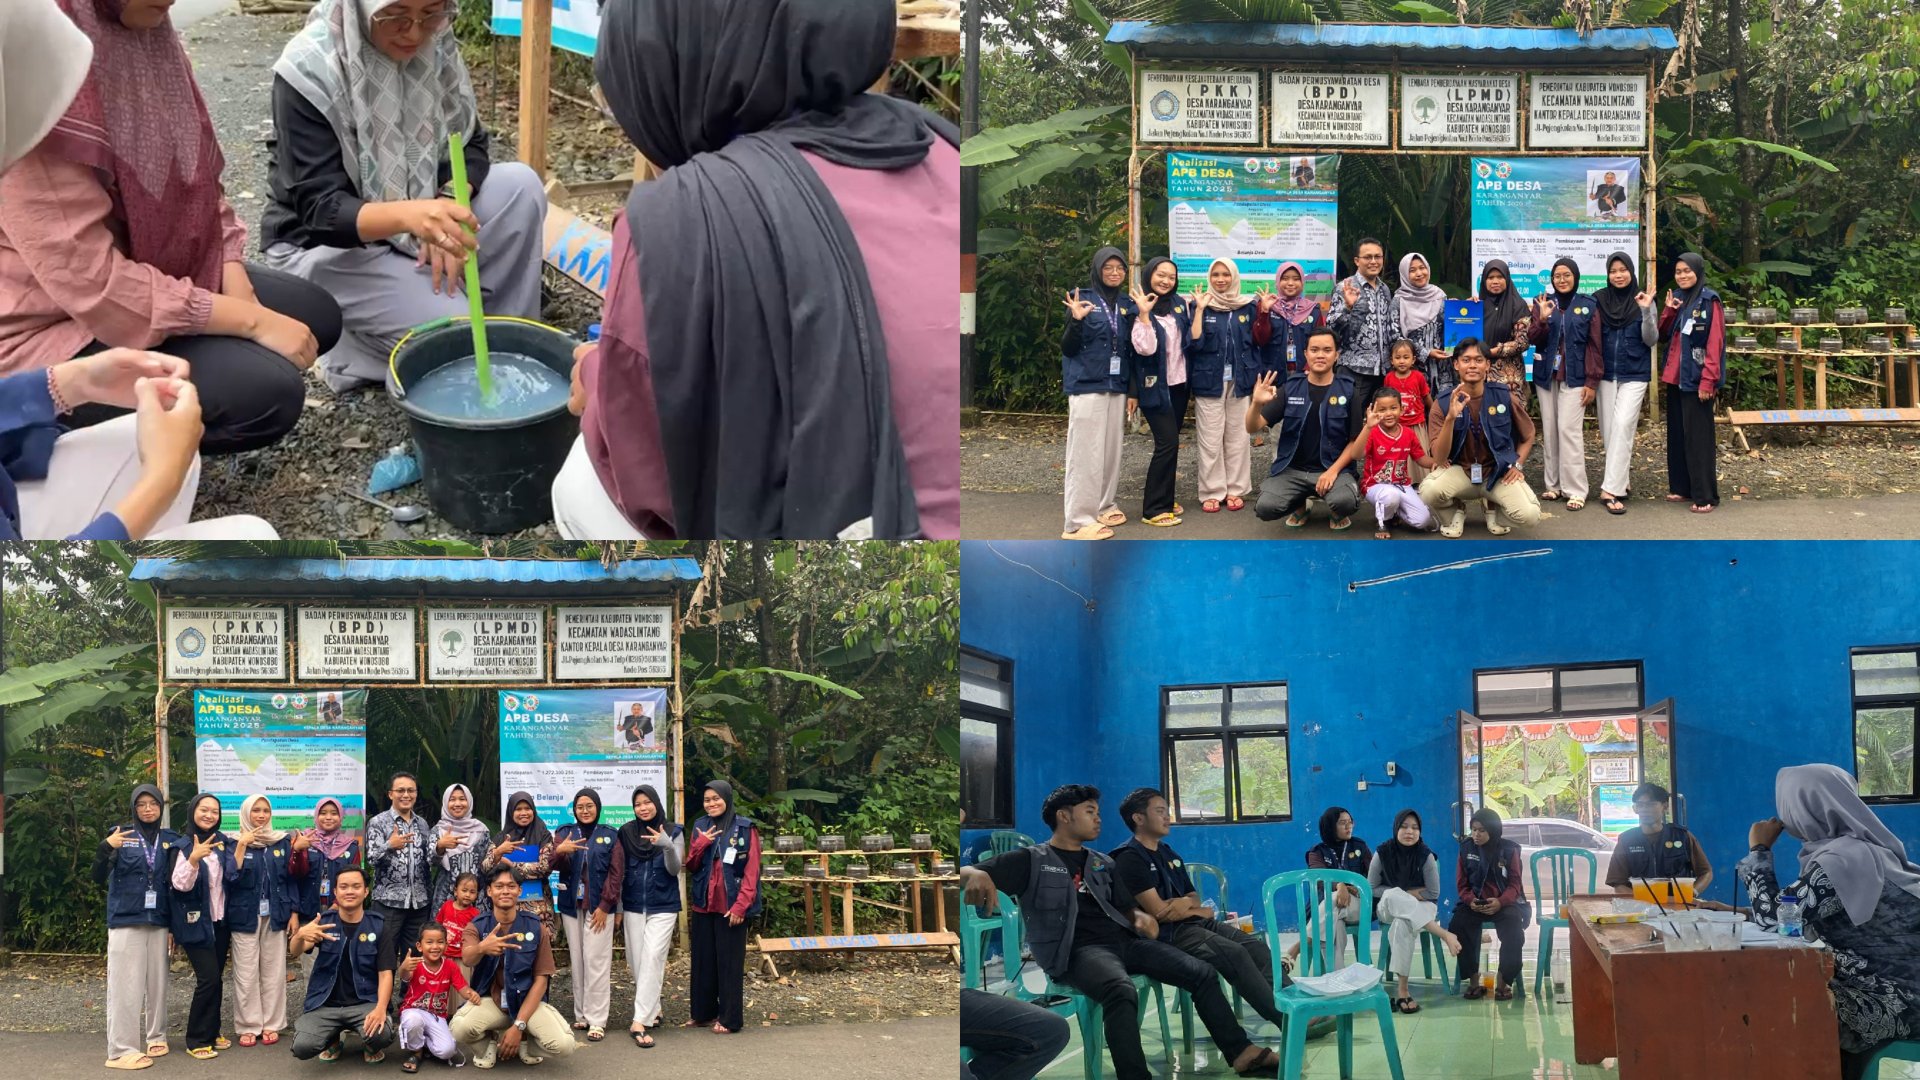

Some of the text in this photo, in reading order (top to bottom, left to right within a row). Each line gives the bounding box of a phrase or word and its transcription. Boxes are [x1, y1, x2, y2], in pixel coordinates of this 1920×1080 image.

[1279, 76, 1299, 84] BADAN
[1364, 78, 1380, 86] DESA
[1575, 83, 1606, 92] KABUPATEN
[1187, 99, 1251, 109] DESA KARANGANYAR
[1298, 100, 1362, 110] DESA KARANGANYAR
[1542, 95, 1634, 106] KECAMATAN WADASLINTANG
[1447, 103, 1510, 113] DESA KARANGANYAR
[1187, 110, 1214, 119] KECAMATAN
[1298, 111, 1325, 120] KECAMATAN
[1447, 114, 1474, 123] KECAMATAN
[1534, 110, 1641, 120] KANTOR KEPALA DESA KARANGANYAR
[1187, 120, 1219, 129] KABUPATEN
[1298, 122, 1330, 130] KABUPATEN
[1447, 125, 1478, 133] KABUPATEN
[1172, 158, 1218, 167] Realisasi
[1172, 168, 1234, 178] APB DESA
[1477, 181, 1542, 191] APB DESA
[601, 614, 632, 623] KABUPATEN
[568, 627, 660, 638] KECAMATAN WADASLINTANG
[213, 635, 277, 645] DESA KARANGANYAR
[324, 635, 389, 645] DESA KARANGANYAR
[474, 636, 536, 646] DESA KARANGANYAR
[213, 646, 240, 655] KECAMATAN
[325, 647, 352, 655] KECAMATAN
[474, 647, 500, 656] KECAMATAN
[561, 642, 667, 652] KANTOR KEPALA DESA KARANGANYAR
[213, 657, 245, 665] KABUPATEN
[474, 658, 505, 666] KABUPATEN
[199, 694, 244, 703] Realisasi
[199, 705, 261, 714] APB DESA
[504, 713, 569, 723] APB DESA
